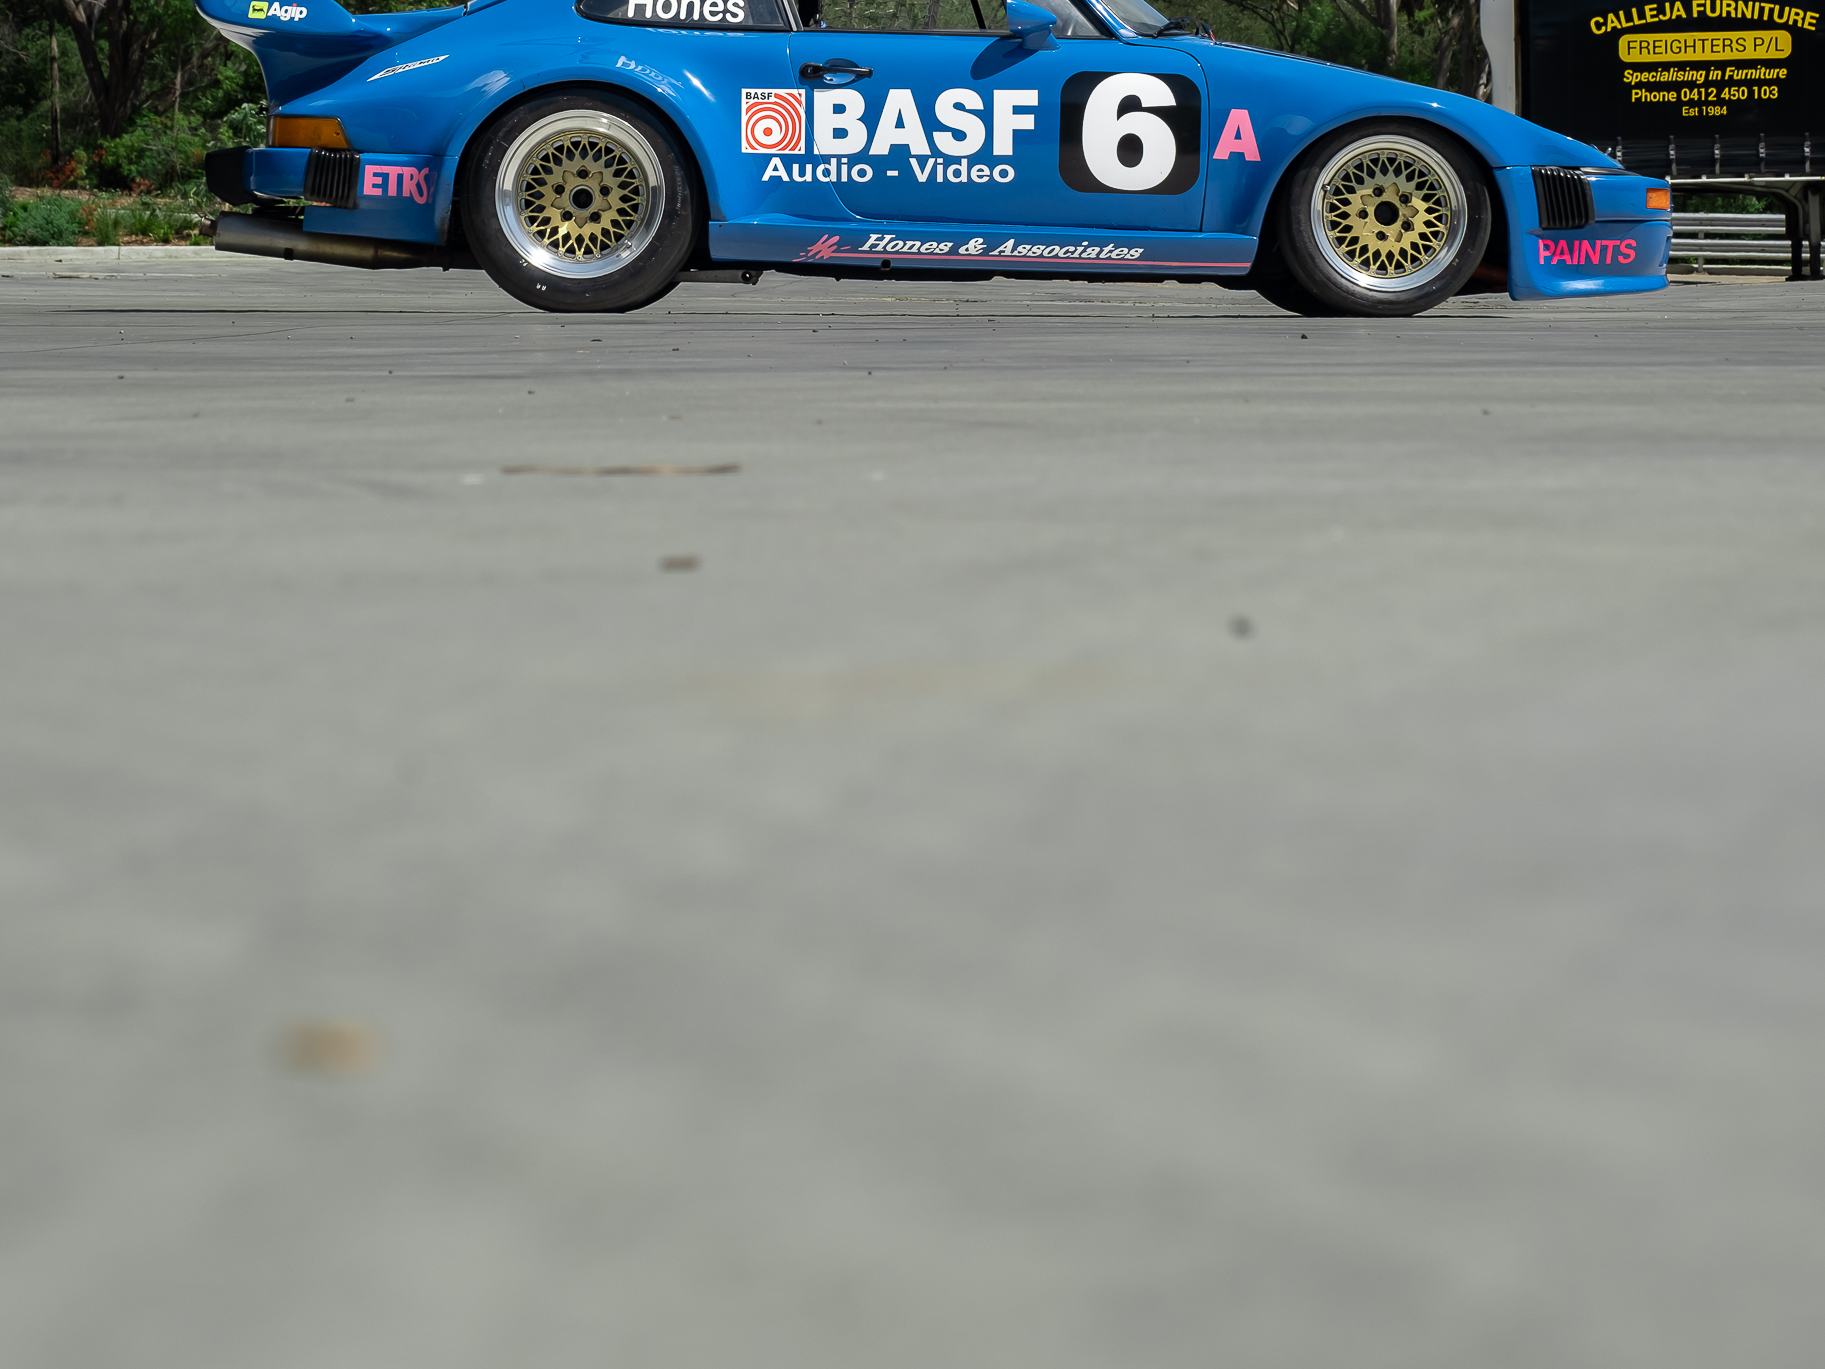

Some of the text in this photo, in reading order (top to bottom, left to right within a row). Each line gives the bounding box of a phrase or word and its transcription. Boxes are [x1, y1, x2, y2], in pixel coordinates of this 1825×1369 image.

[267, 1, 308, 21] Agip
[1590, 0, 1820, 35] CALLEJA FURNITURE
[1627, 36, 1785, 56] FREIGHTERS P/L
[1623, 65, 1788, 85] Specialising in Furniture
[745, 91, 773, 101] BASF
[1631, 86, 1779, 103] Phone 0412 450 103
[813, 88, 1039, 157] BASF
[1682, 105, 1728, 117] Est 1984
[1081, 72, 1178, 192] 6
[1212, 108, 1262, 162] A
[761, 156, 874, 183] Audio
[909, 157, 1015, 183] Video
[858, 233, 954, 255] Hones
[958, 237, 989, 255] &
[989, 238, 1145, 260] Associates
[1538, 238, 1637, 265] PAINTS
